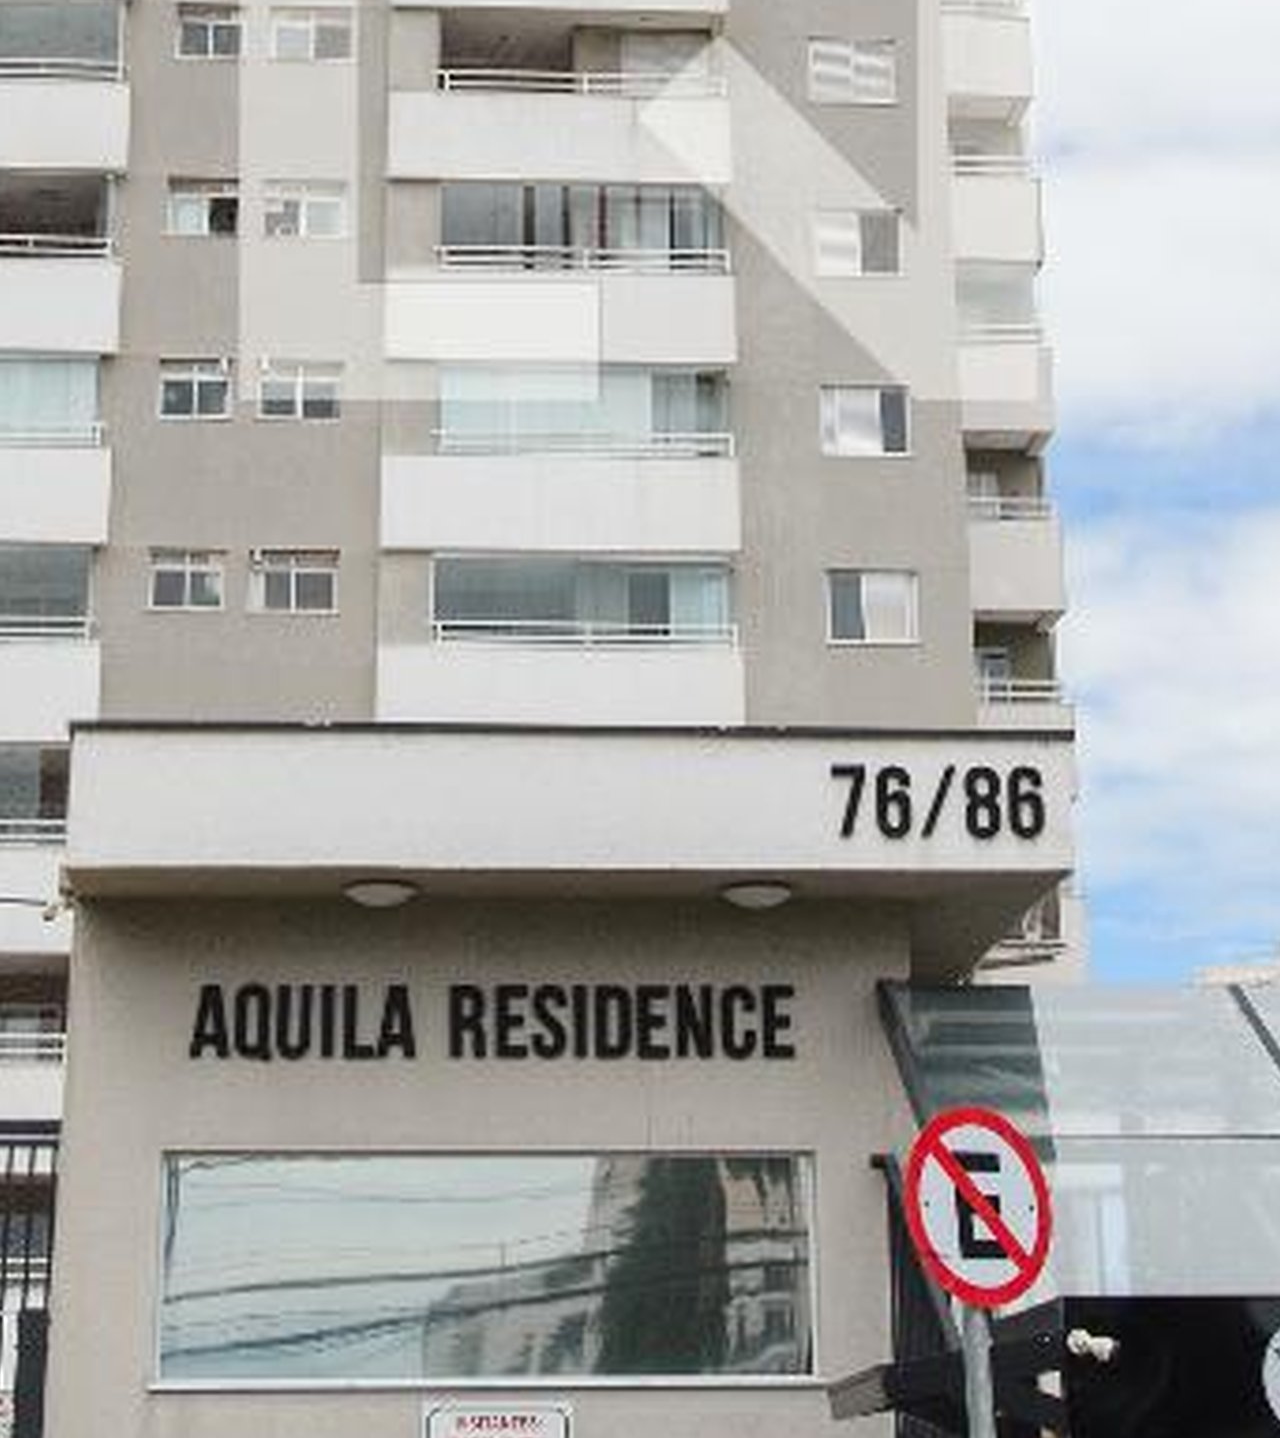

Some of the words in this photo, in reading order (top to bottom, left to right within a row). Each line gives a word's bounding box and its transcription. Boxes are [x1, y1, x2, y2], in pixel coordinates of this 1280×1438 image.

[829, 762, 1046, 841] 76/86
[189, 983, 417, 1062] AQUILA
[448, 983, 797, 1061] RESIDENCE
[952, 1151, 1011, 1259] E
